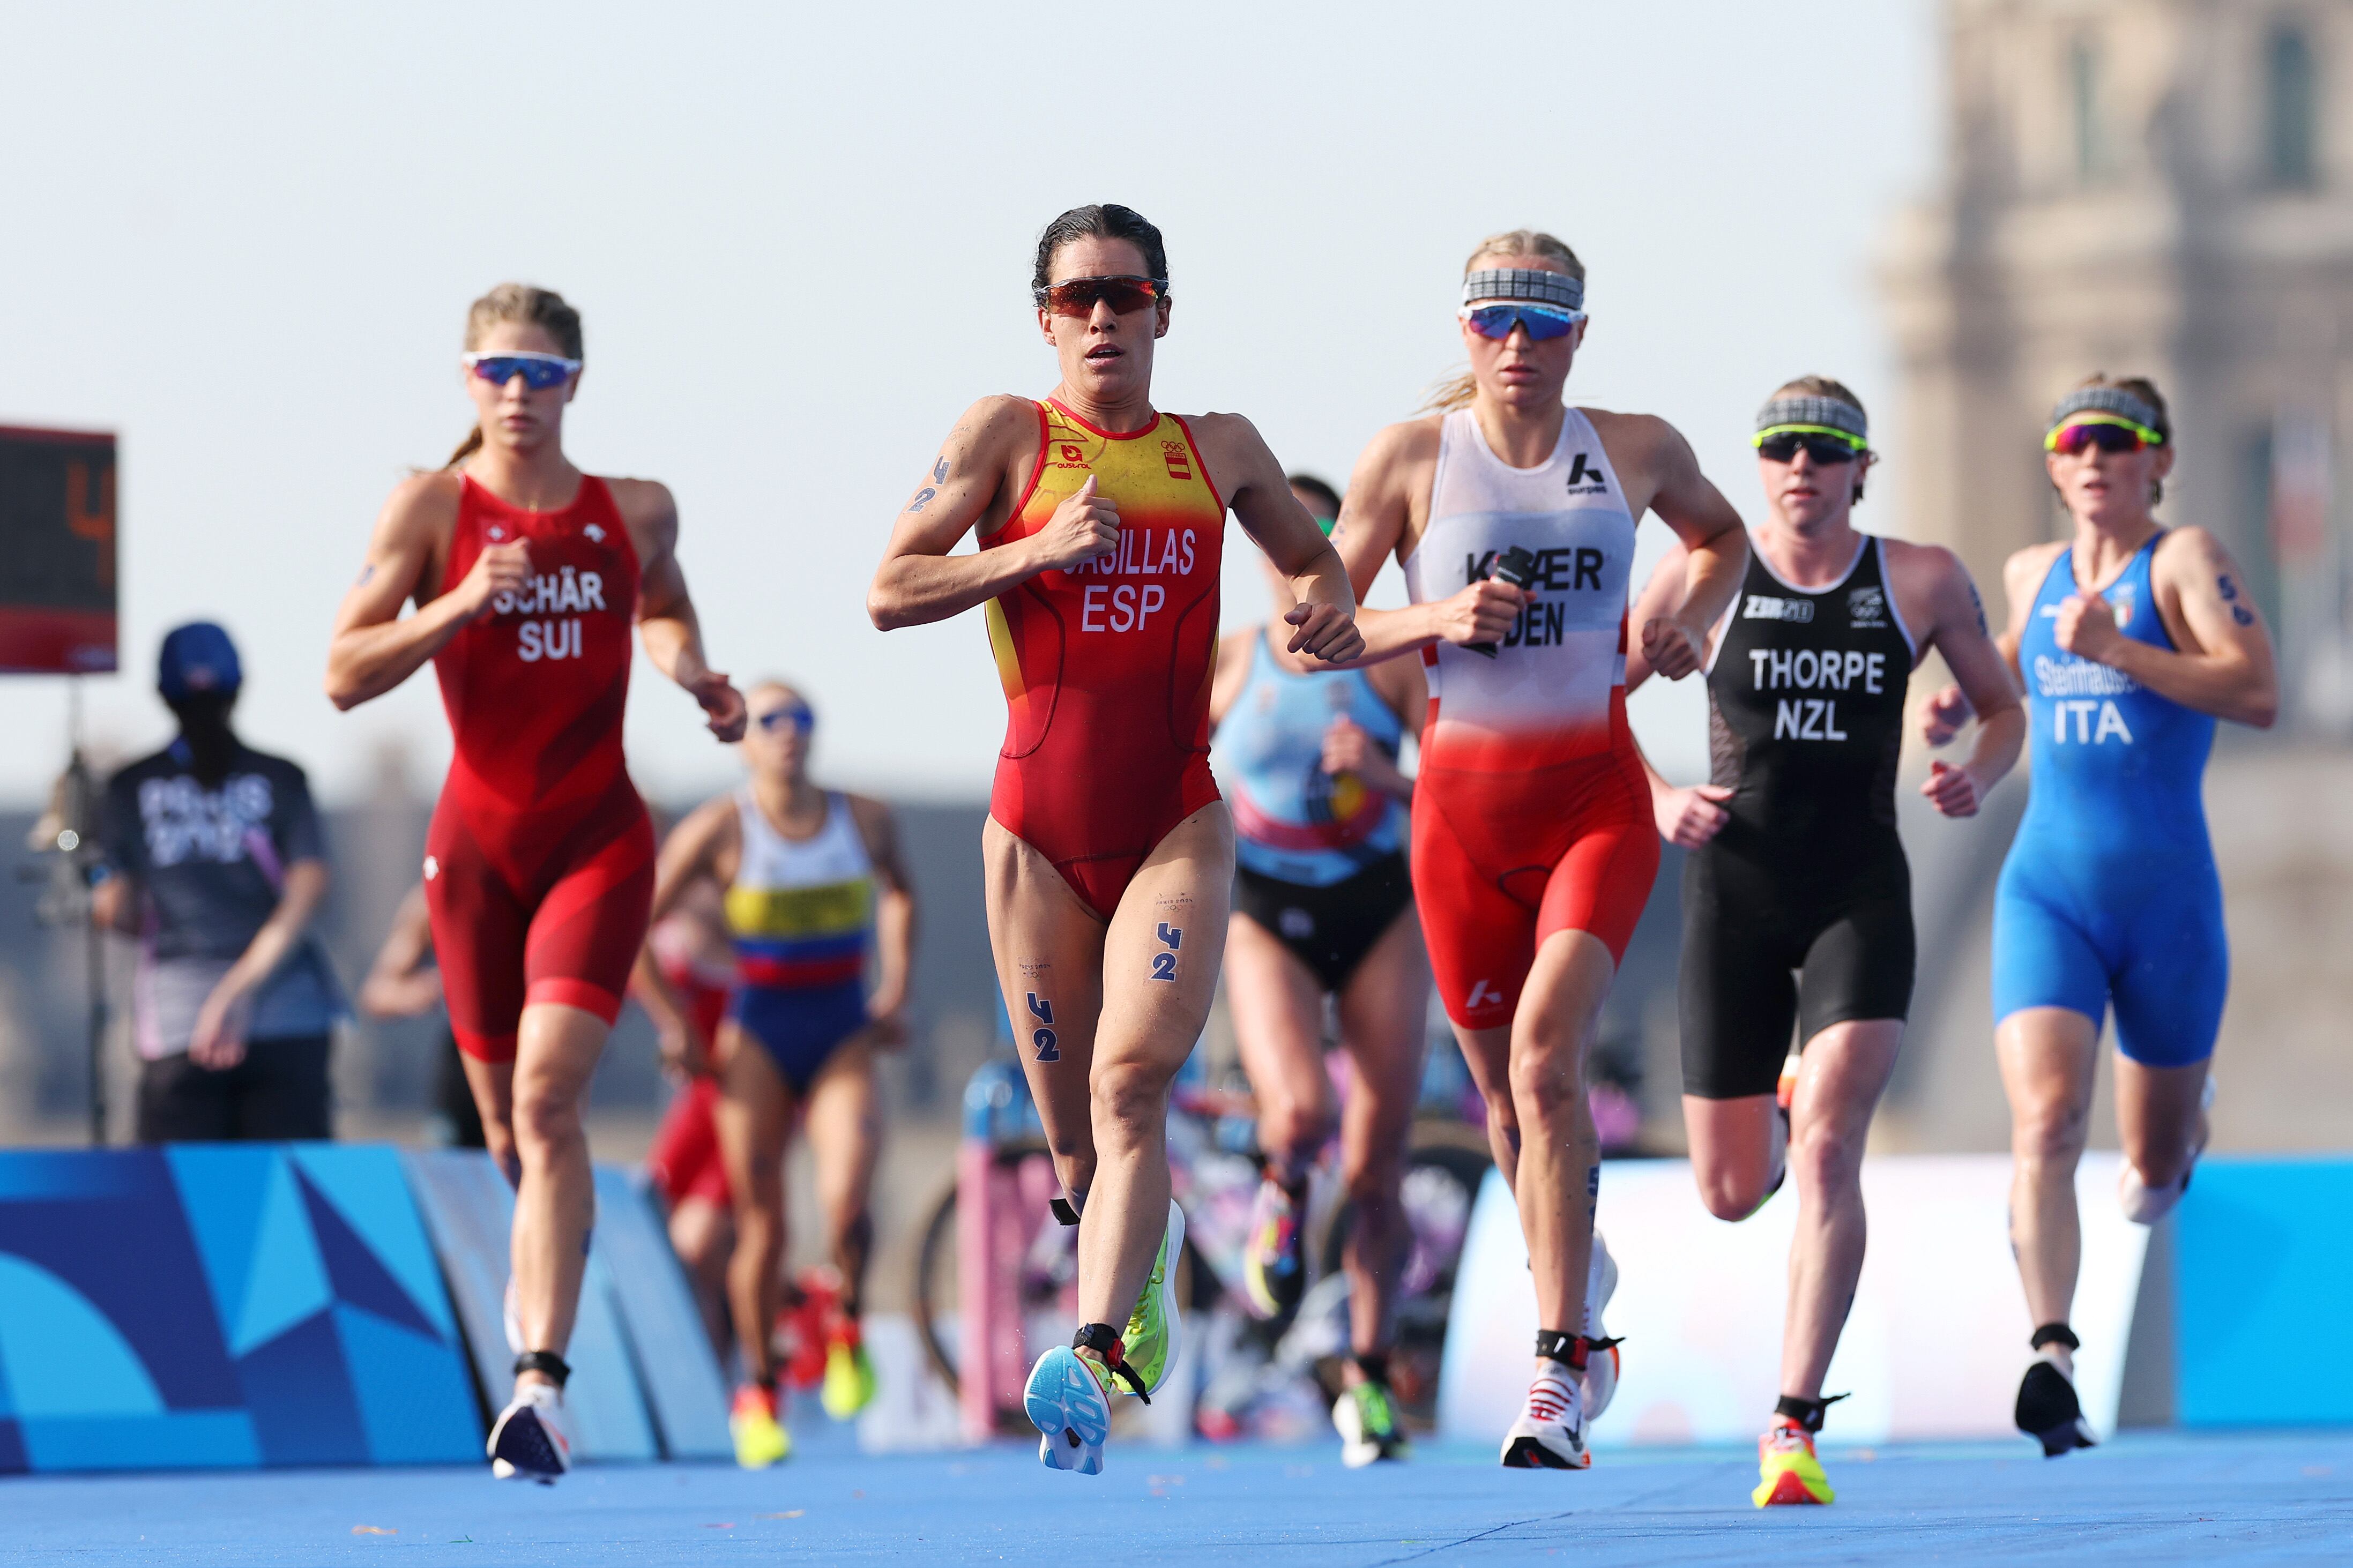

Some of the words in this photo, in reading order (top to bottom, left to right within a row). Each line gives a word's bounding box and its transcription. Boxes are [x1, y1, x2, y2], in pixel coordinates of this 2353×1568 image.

[1063, 528, 1196, 575] ASILLAS
[1467, 547, 1604, 591] KÆR
[1082, 584, 1166, 632] ESP
[517, 617, 583, 663] SUI
[1748, 648, 1886, 695] THORPE
[1774, 698, 1848, 742] NZL
[2054, 700, 2134, 745] ITA
